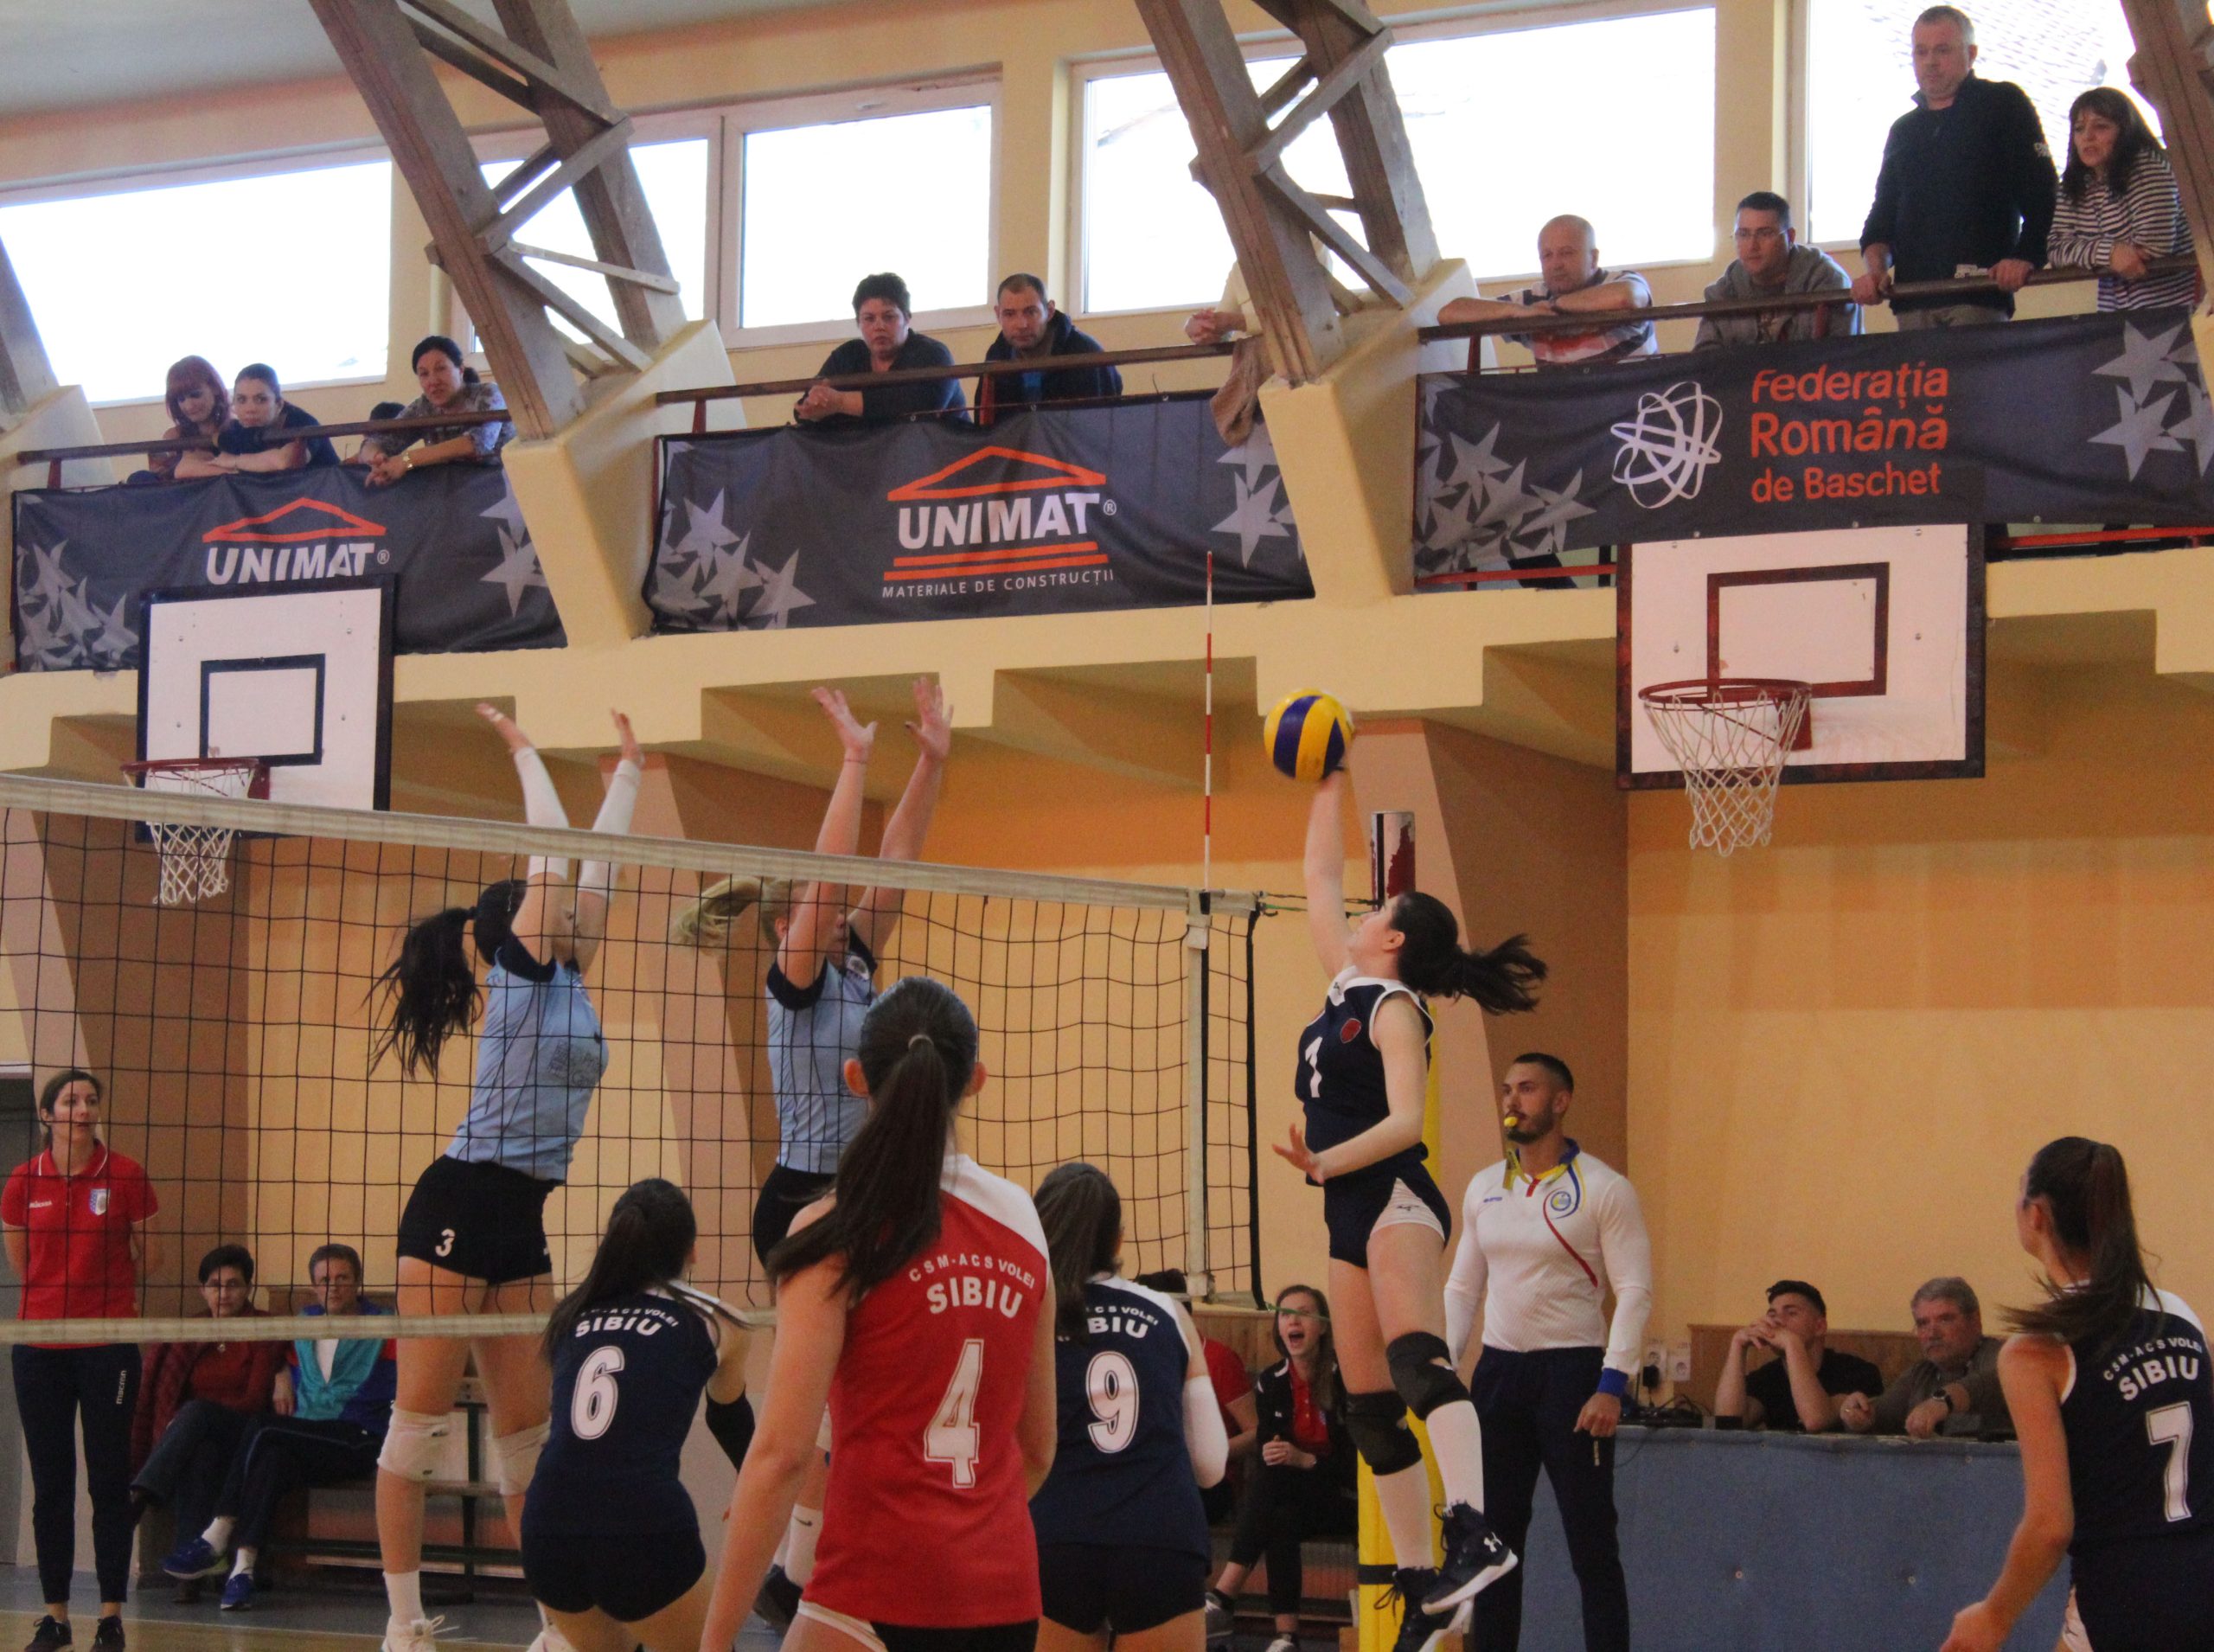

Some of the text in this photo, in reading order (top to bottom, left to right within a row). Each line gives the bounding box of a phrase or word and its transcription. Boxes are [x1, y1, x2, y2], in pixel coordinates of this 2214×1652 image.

[1751, 361, 1948, 409] Federația
[1750, 403, 1948, 458] Română
[1751, 461, 1941, 503] de Baschet
[882, 580, 967, 599] MATERIALE
[976, 579, 995, 592] DE
[1305, 1036, 1323, 1098] 1
[435, 1228, 455, 1257] 3
[998, 1259, 1035, 1289] VOLEI
[926, 1276, 1023, 1318] SIBIU
[1121, 1306, 1158, 1326] VOLEI
[575, 1316, 662, 1337] SIBIU
[571, 1346, 625, 1440] 6
[2119, 1355, 2198, 1400] SIBIU
[924, 1339, 984, 1489] 4
[1086, 1351, 1140, 1453] 9
[2146, 1400, 2193, 1522] 7
